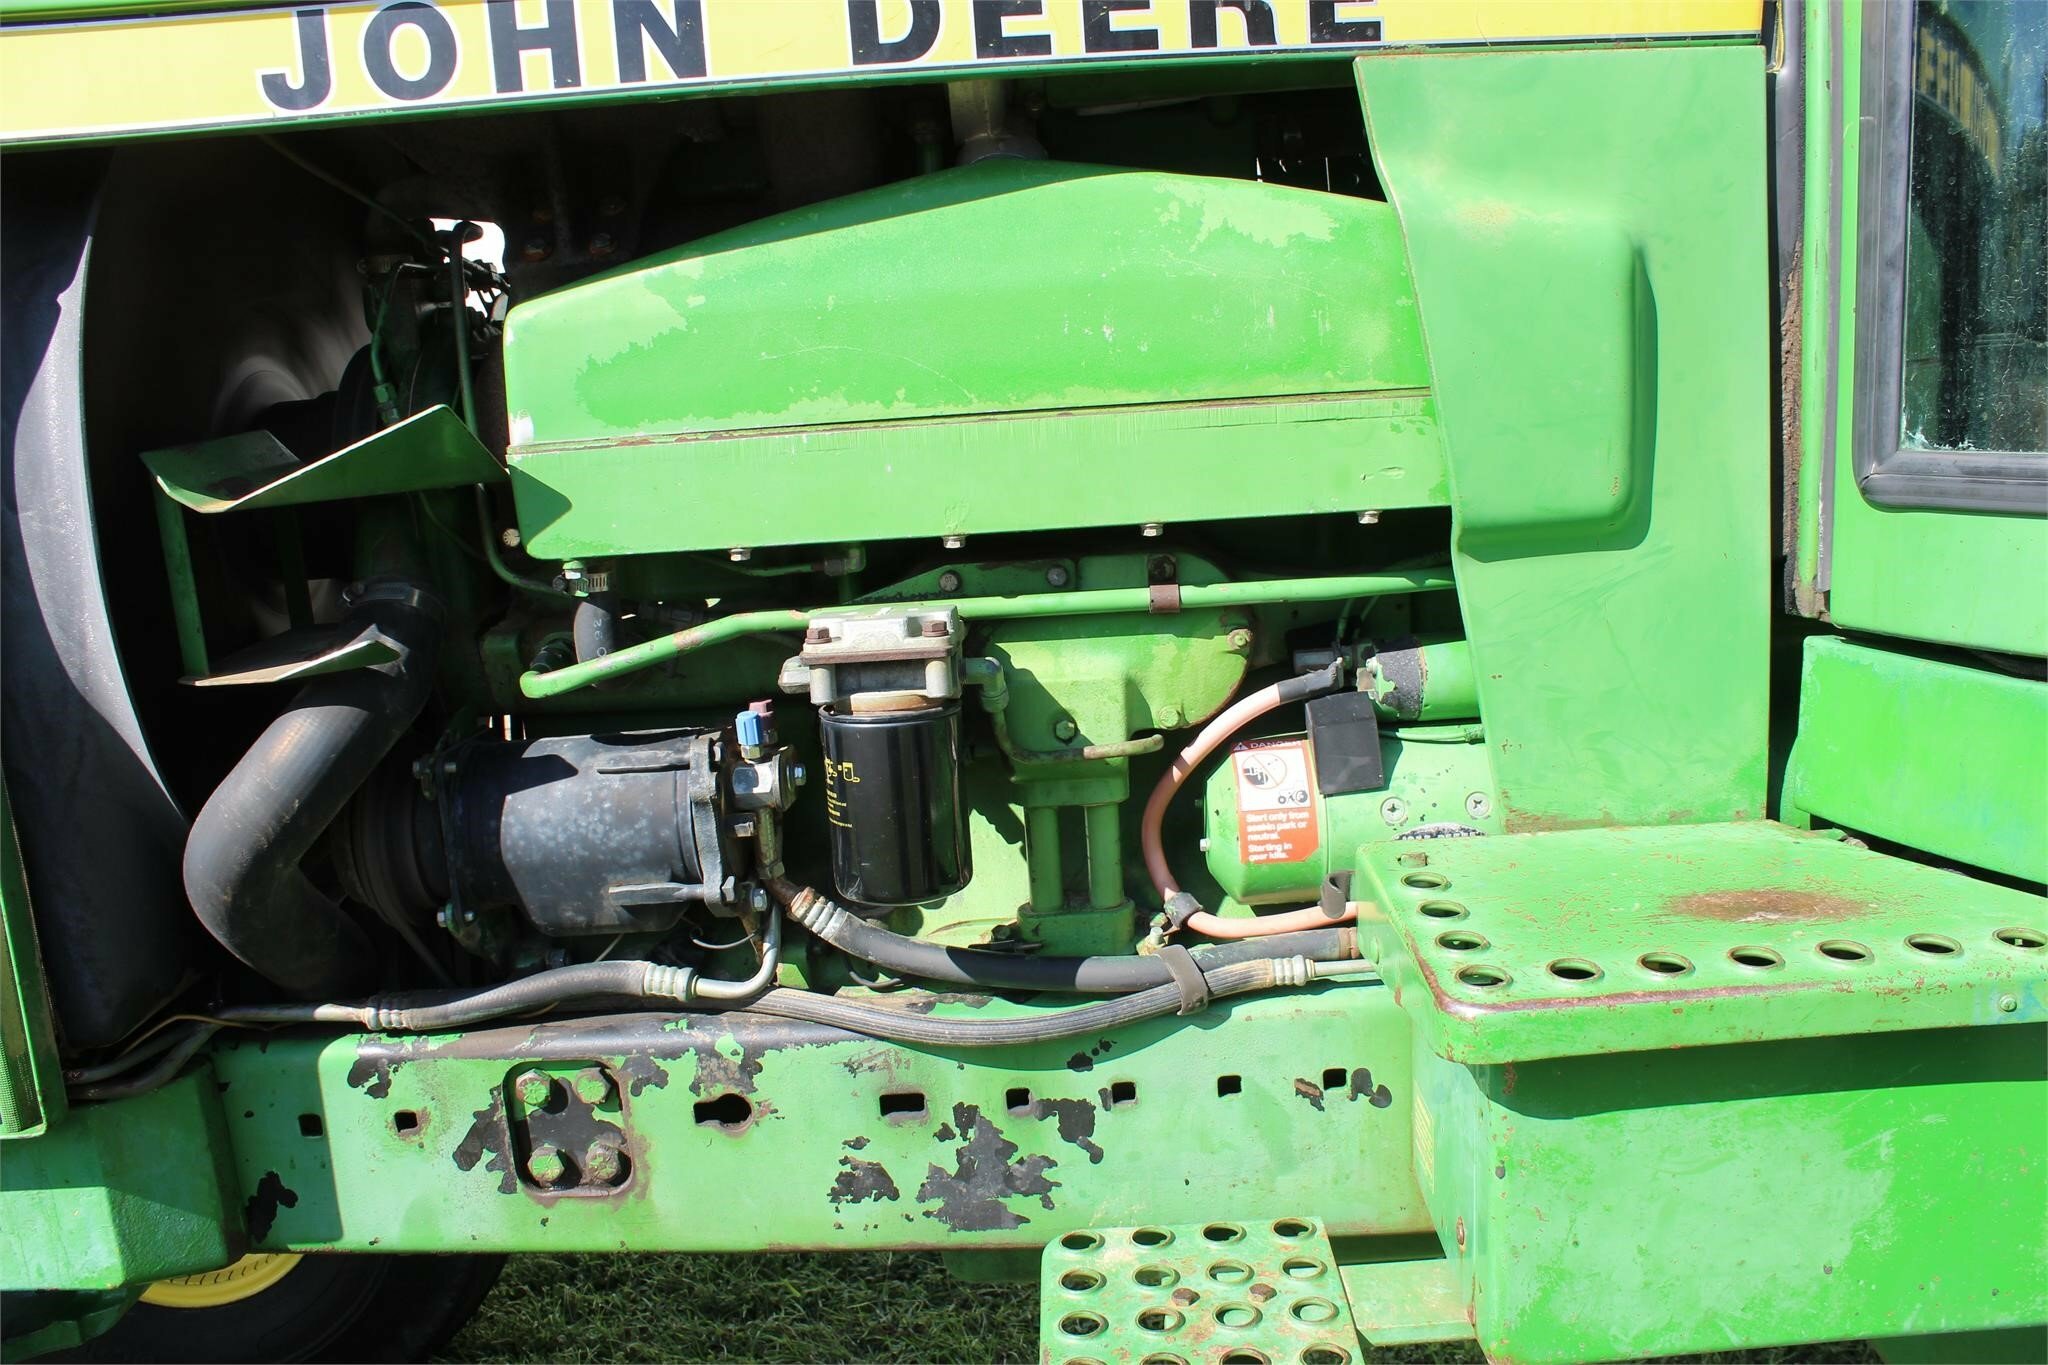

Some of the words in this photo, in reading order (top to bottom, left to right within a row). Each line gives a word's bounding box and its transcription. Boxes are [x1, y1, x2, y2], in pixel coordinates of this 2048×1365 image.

[261, 0, 708, 110] JOHN
[1268, 812, 1287, 822] only
[1288, 811, 1309, 819] from
